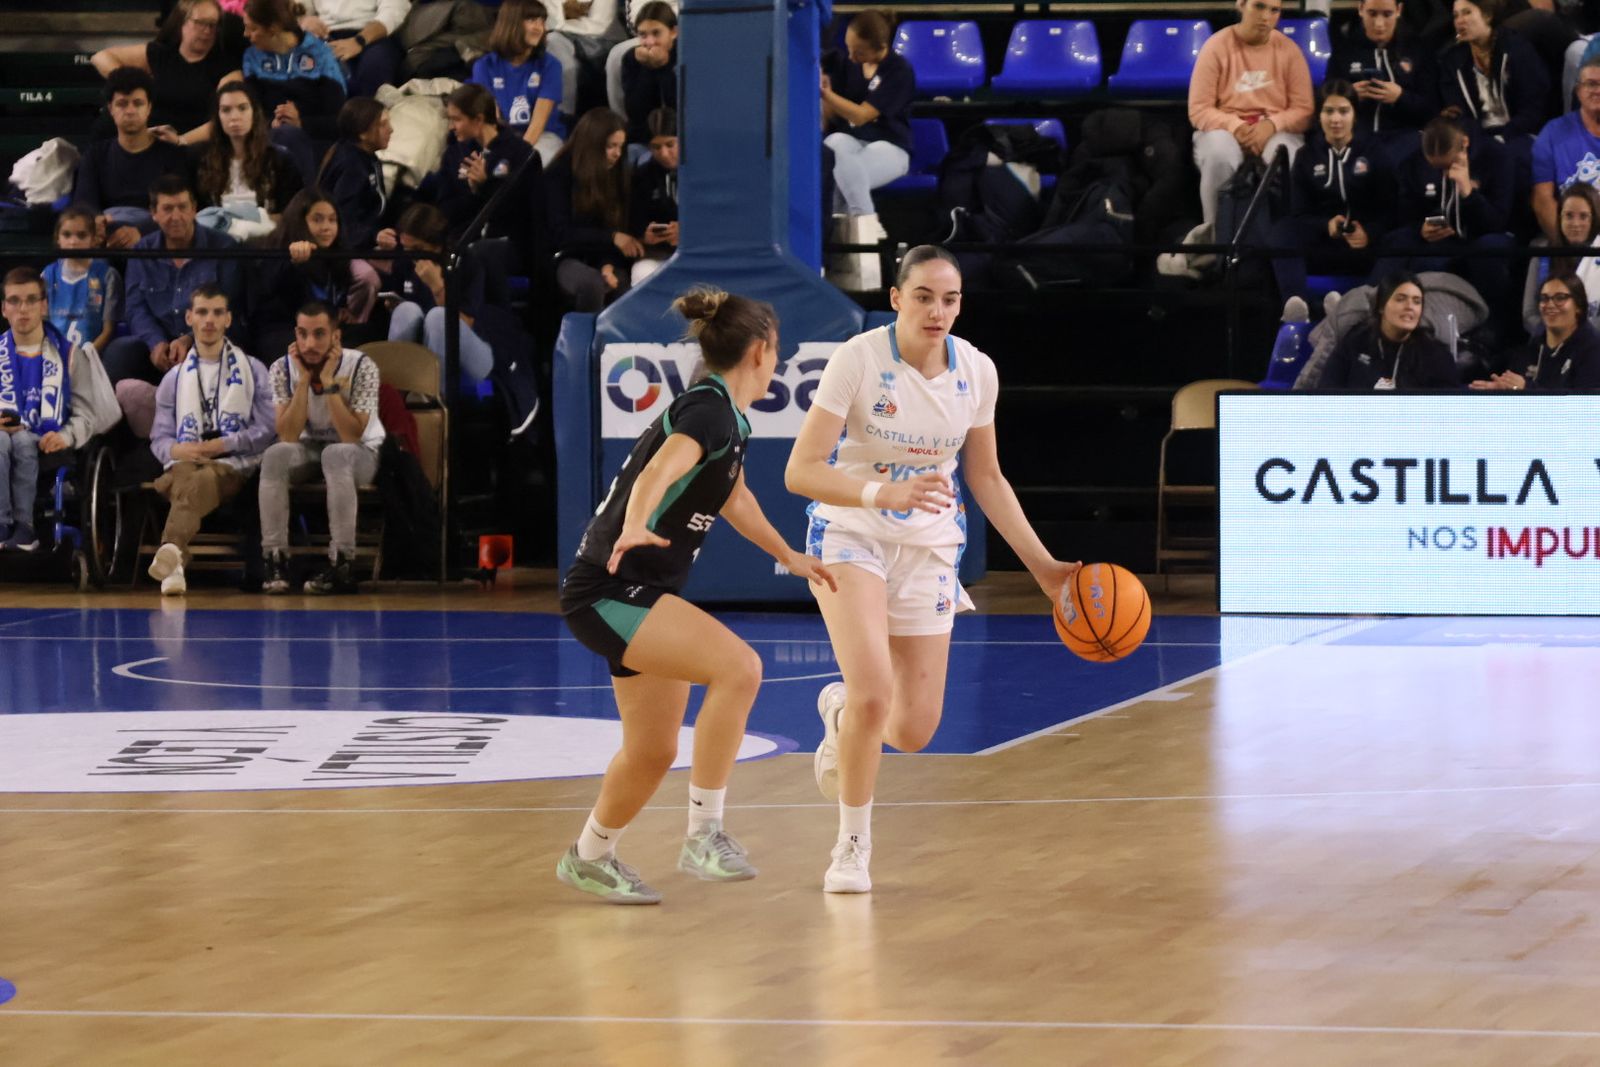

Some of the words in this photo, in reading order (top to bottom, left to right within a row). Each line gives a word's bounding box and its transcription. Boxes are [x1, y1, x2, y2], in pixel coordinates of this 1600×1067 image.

[20, 92, 43, 102] FILA
[45, 92, 53, 102] 4
[67, 320, 81, 345] 6
[865, 424, 925, 446] CASTILLA
[933, 437, 941, 448] Y
[1255, 457, 1559, 505] CASTILLA
[1407, 525, 1478, 551] NOS
[303, 715, 509, 782] CASTILLA
